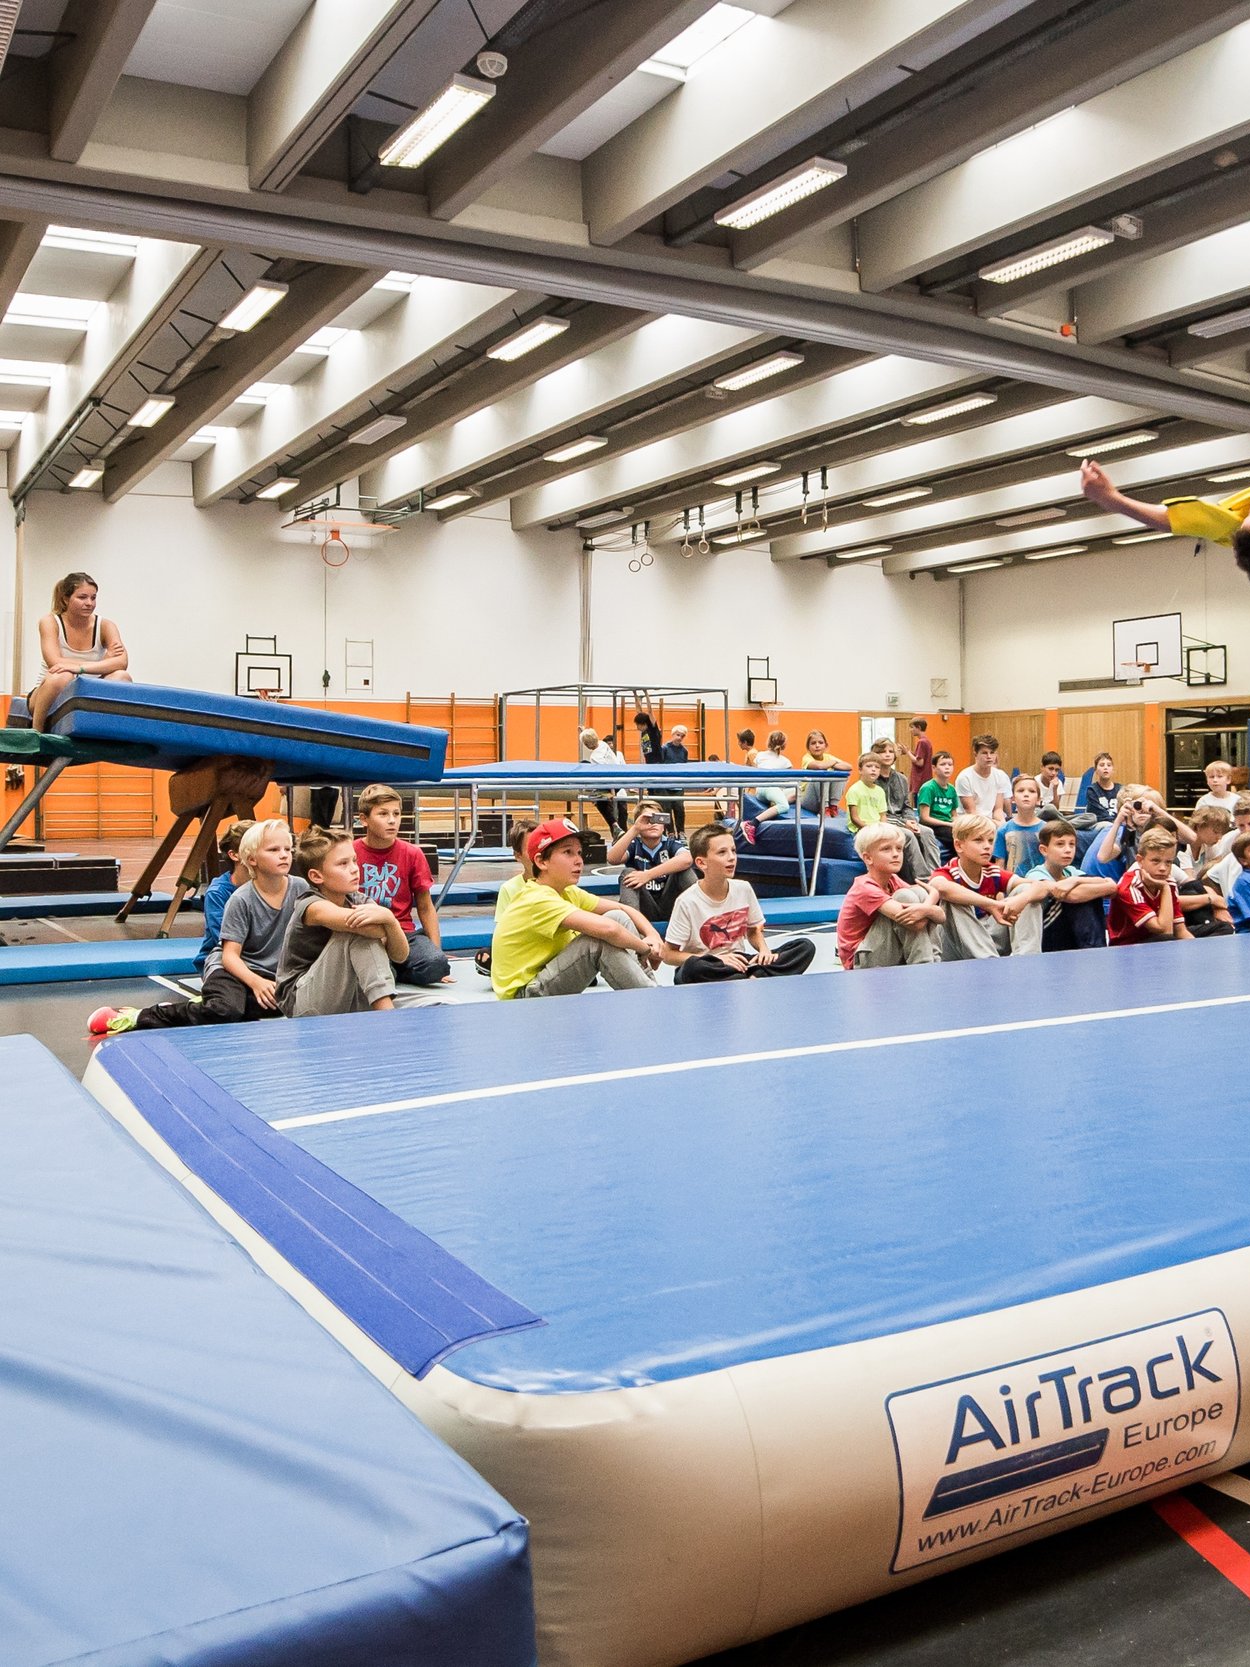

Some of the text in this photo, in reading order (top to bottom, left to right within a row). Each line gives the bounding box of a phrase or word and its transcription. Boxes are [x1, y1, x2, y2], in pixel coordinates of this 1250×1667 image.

[362, 861, 398, 884] BUR
[944, 1335, 1223, 1465] AirTrack
[1123, 1402, 1223, 1449] Europe
[917, 1439, 1217, 1552] www.AirTrack-Europe.com
